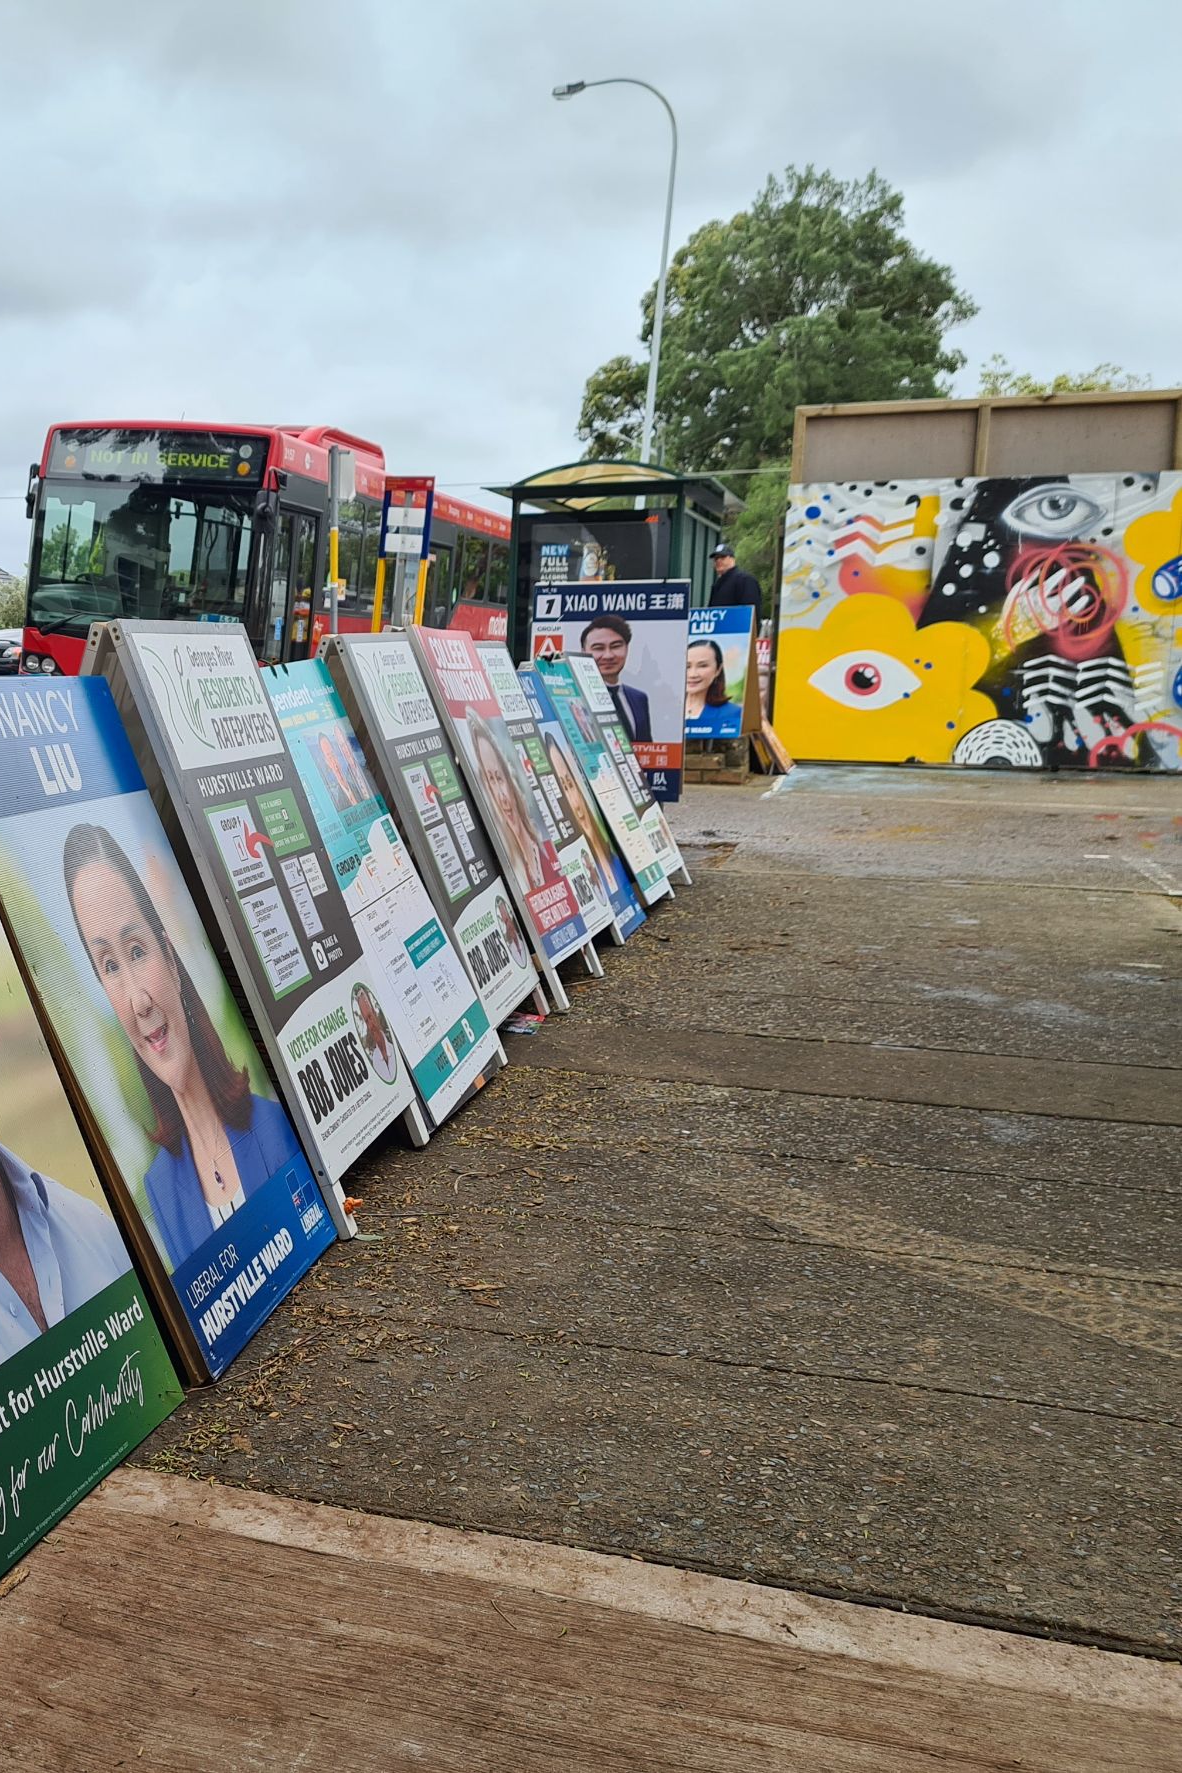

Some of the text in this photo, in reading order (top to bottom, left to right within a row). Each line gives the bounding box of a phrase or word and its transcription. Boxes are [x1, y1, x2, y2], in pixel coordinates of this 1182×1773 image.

[91, 450, 231, 468] NOT IN SERVICE
[540, 556, 568, 567] FULL
[541, 544, 568, 556] NEW
[545, 598, 556, 614] 1
[564, 593, 597, 612] XIAO
[602, 593, 646, 612] WANG
[691, 621, 715, 633] LIU
[186, 645, 235, 672] Georges River
[538, 637, 557, 658] A
[197, 675, 262, 710] RESIDENTS &
[210, 712, 276, 750] RATEPAYERS
[633, 744, 668, 752] STVILLE
[29, 743, 82, 796] LIU
[197, 763, 284, 798] HURSTVILLE WARD
[220, 816, 238, 832] GROUP
[336, 854, 356, 876] GROUP
[322, 936, 333, 949] TAKE
[327, 947, 344, 963] PHOTO
[467, 945, 491, 989] BOB
[482, 929, 510, 976] JONES
[287, 1006, 348, 1062] VOTE CHANGE
[461, 1018, 475, 1043] B
[297, 1059, 335, 1125] BOB
[324, 1031, 368, 1103] JONES
[186, 1243, 239, 1309] LIBERAL FOR
[199, 1258, 267, 1346] HURSTVILLE
[259, 1227, 294, 1275] WARD
[7, 1384, 35, 1421] for
[34, 1329, 109, 1399] Hurstville
[104, 1295, 144, 1341] Ward
[10, 1458, 30, 1518] for
[37, 1433, 59, 1474] our
[65, 1350, 143, 1457] Community
